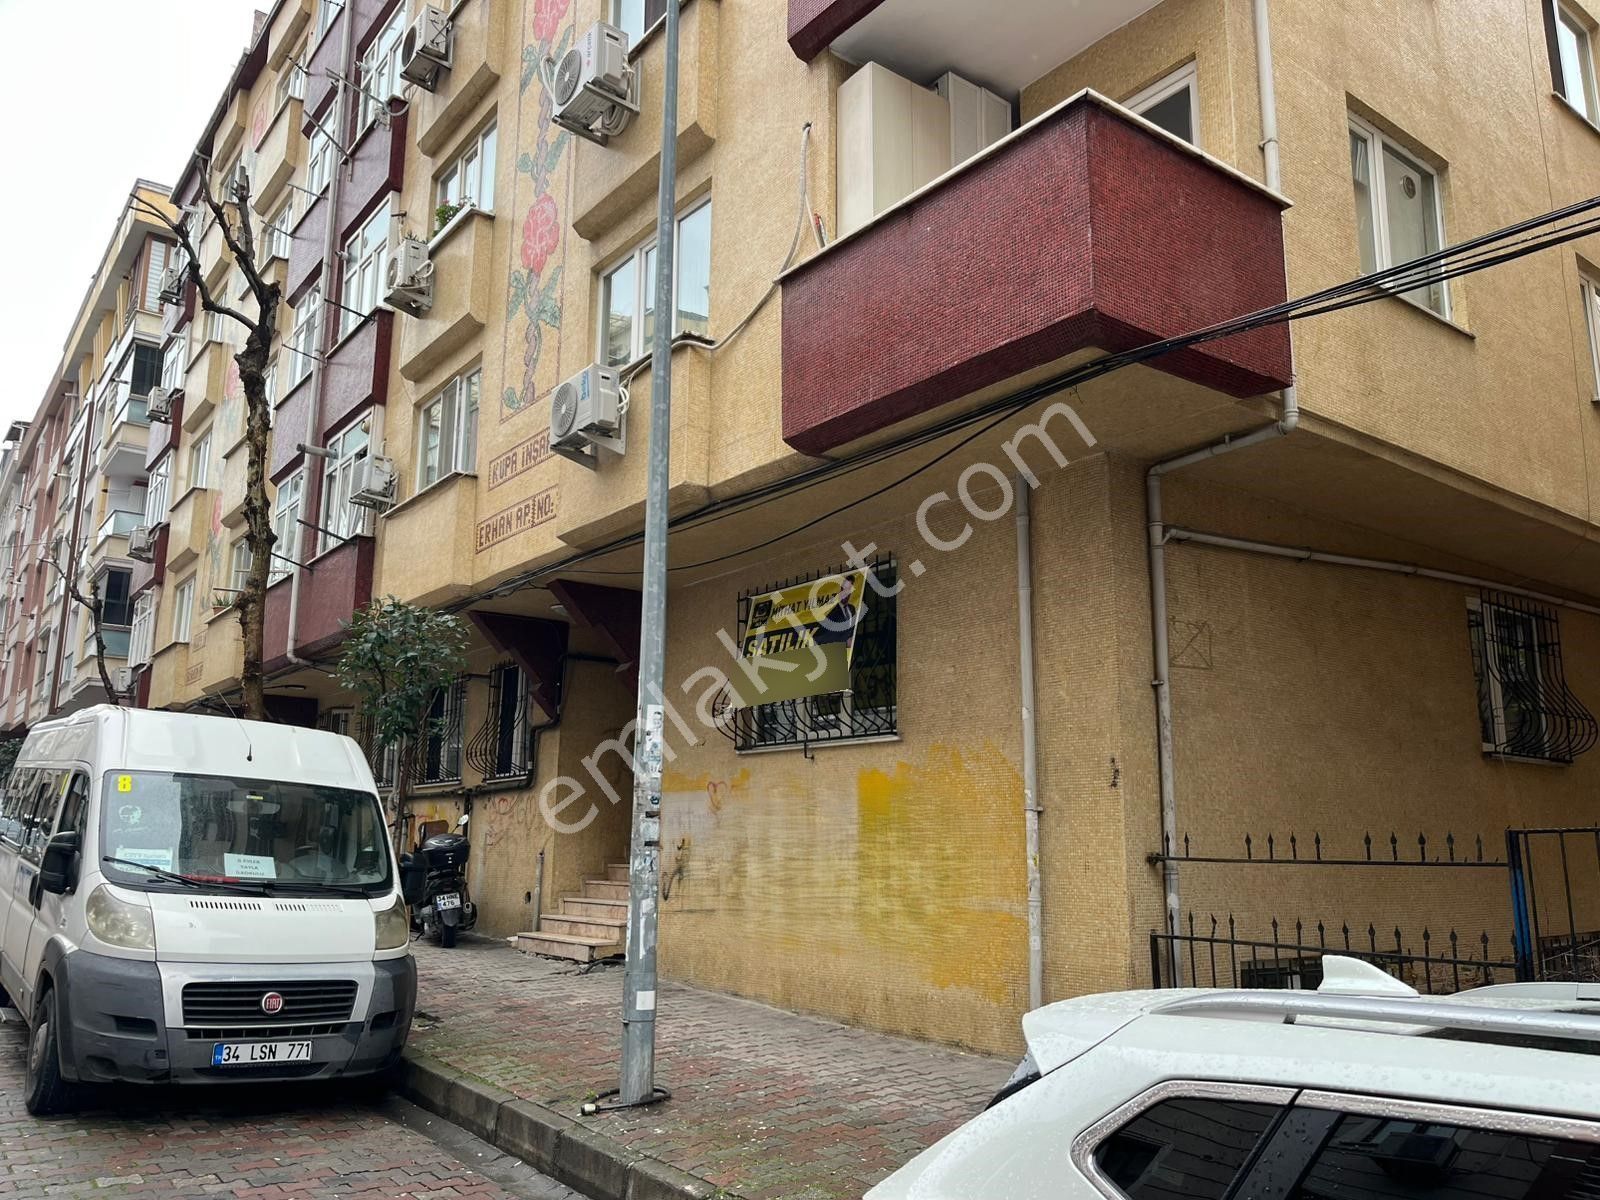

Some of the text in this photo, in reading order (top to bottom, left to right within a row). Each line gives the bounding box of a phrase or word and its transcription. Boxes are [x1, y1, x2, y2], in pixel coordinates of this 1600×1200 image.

[492, 451, 518, 484] KUPA
[479, 514, 513, 547] ERHAN
[749, 627, 818, 657] SATILIK
[266, 998, 280, 1009] FIAT
[223, 1046, 240, 1062] 34
[250, 1044, 277, 1061] LSN
[287, 1043, 310, 1059] 771
